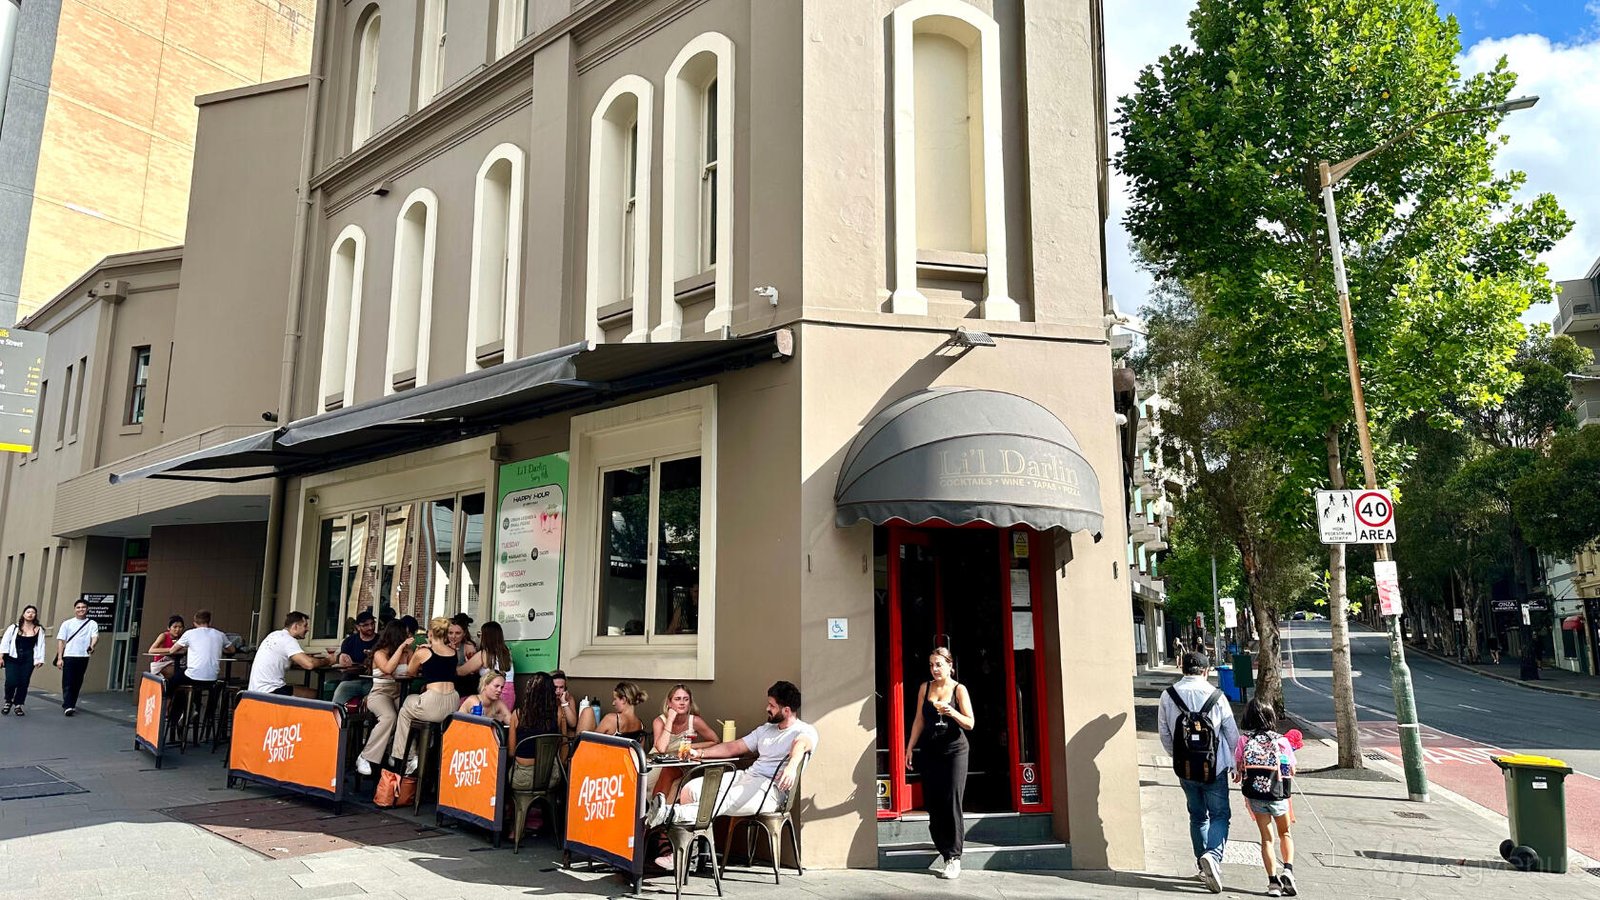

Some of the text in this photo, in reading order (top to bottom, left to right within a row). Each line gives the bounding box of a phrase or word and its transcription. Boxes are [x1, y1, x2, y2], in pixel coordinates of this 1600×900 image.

[6, 339, 23, 347] Street
[1000, 449, 1080, 486] Darlin
[939, 477, 993, 488] COCKTAILS
[1001, 478, 1026, 487] WINE
[1033, 480, 1057, 491] TAPAS
[513, 490, 550, 503] HAPPY HOUR
[1361, 502, 1387, 517] 40
[1360, 529, 1394, 540] AREA
[501, 541, 520, 549] TUESDAY
[263, 723, 302, 751] APEROL
[449, 748, 488, 776] APEROL
[578, 774, 624, 806] APEROL
